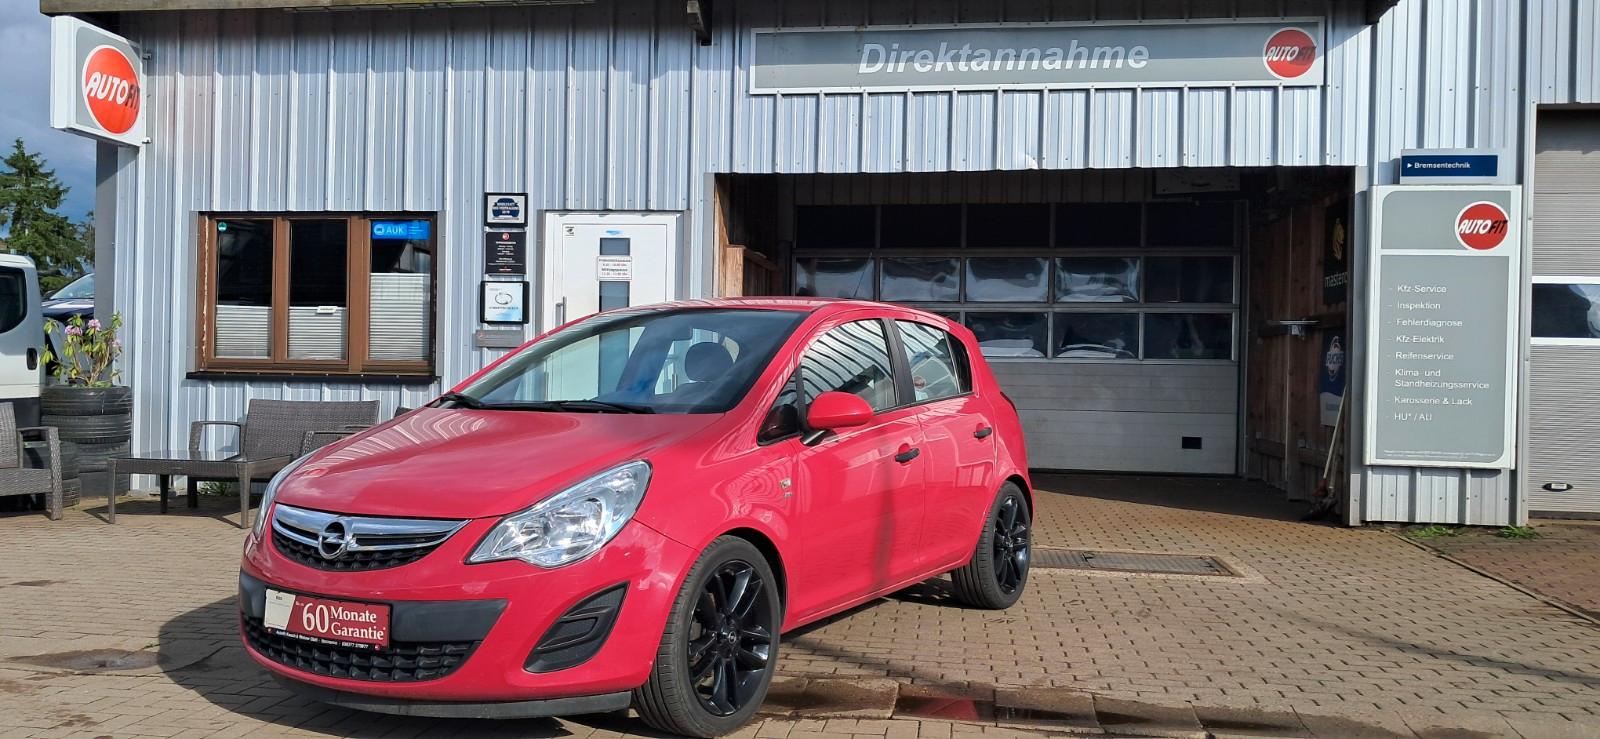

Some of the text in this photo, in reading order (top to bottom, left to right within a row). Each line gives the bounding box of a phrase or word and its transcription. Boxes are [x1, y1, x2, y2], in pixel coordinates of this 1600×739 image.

[858, 39, 1149, 74] Direktannahme
[1265, 45, 1316, 62] AUTOFIT
[1458, 219, 1509, 234] AUTOFIT
[1397, 284, 1447, 293] Kfz-Service
[1397, 301, 1441, 310] Inspektion
[1396, 318, 1463, 328] Fehlerdiagnose
[1396, 335, 1445, 343] Kfz-Elektrik
[1395, 352, 1454, 360] Reifenservice
[1424, 369, 1441, 377] und
[1394, 379, 1490, 389] Standheizungsservice
[1394, 396, 1472, 406] Karosserie & Lack
[302, 602, 377, 633] 60 Monate
